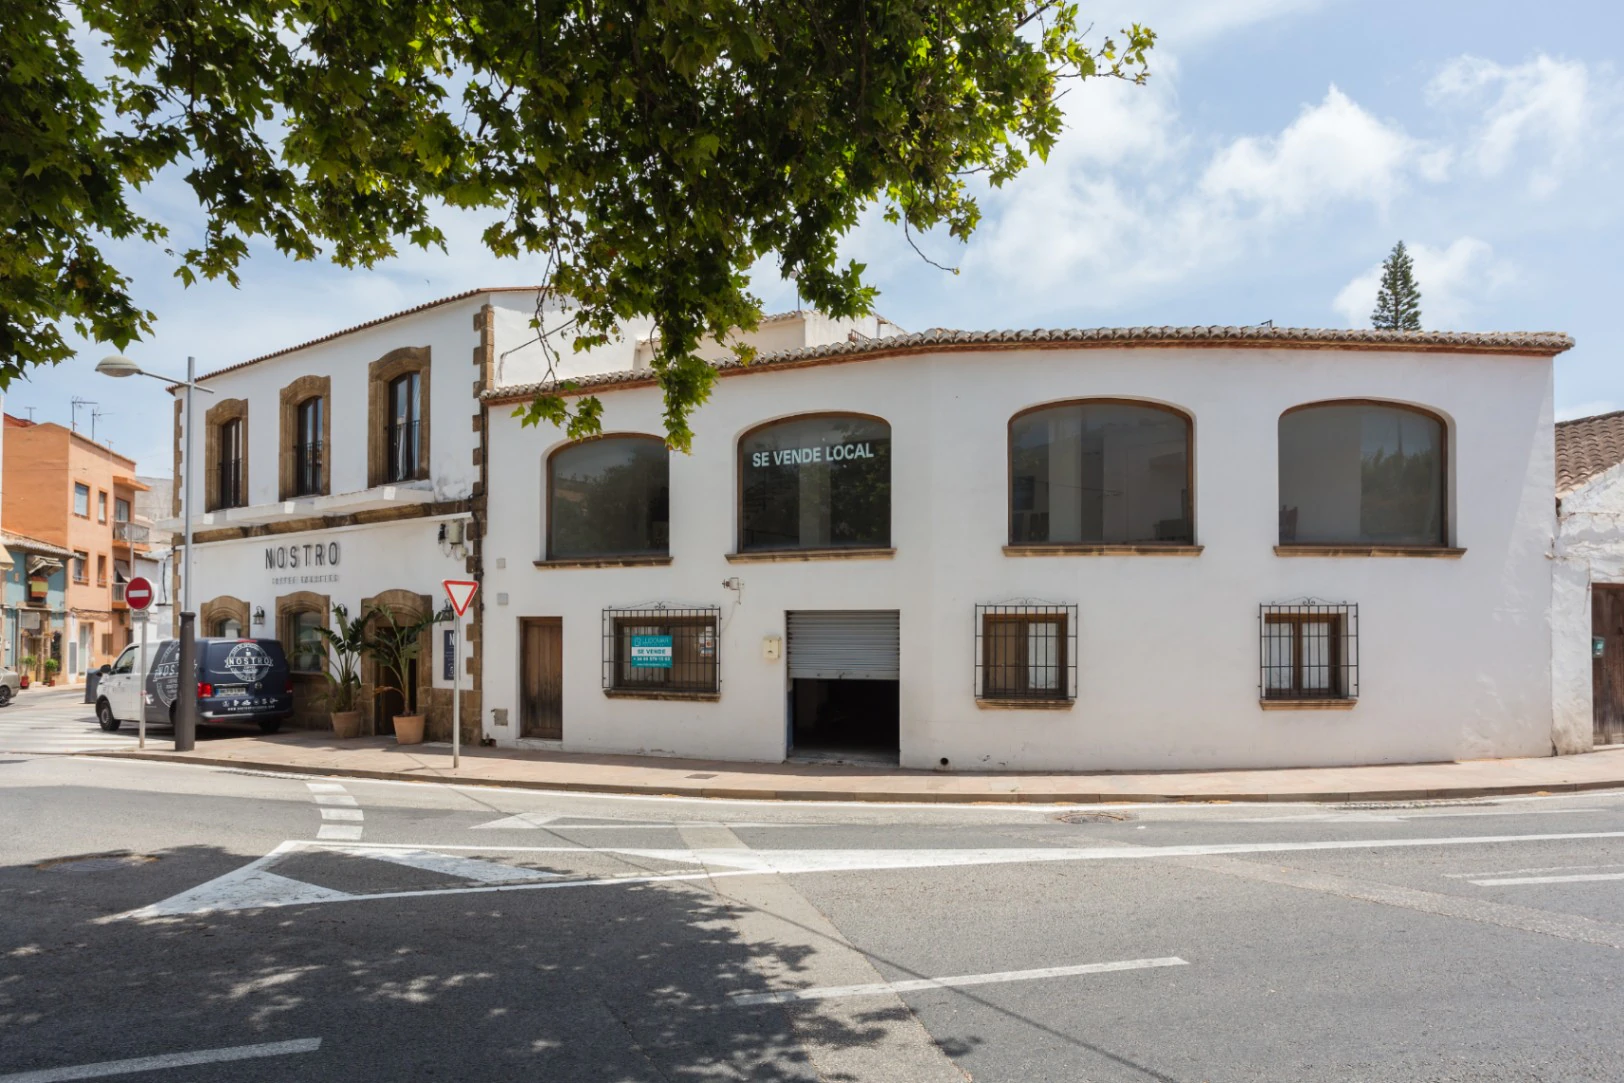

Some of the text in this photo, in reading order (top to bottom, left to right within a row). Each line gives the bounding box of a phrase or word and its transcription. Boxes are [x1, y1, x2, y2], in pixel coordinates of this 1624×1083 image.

[752, 442, 874, 467] SE VENDE LOCAL
[265, 541, 338, 569] NOSTRO
[229, 656, 270, 666] NOSTRO
